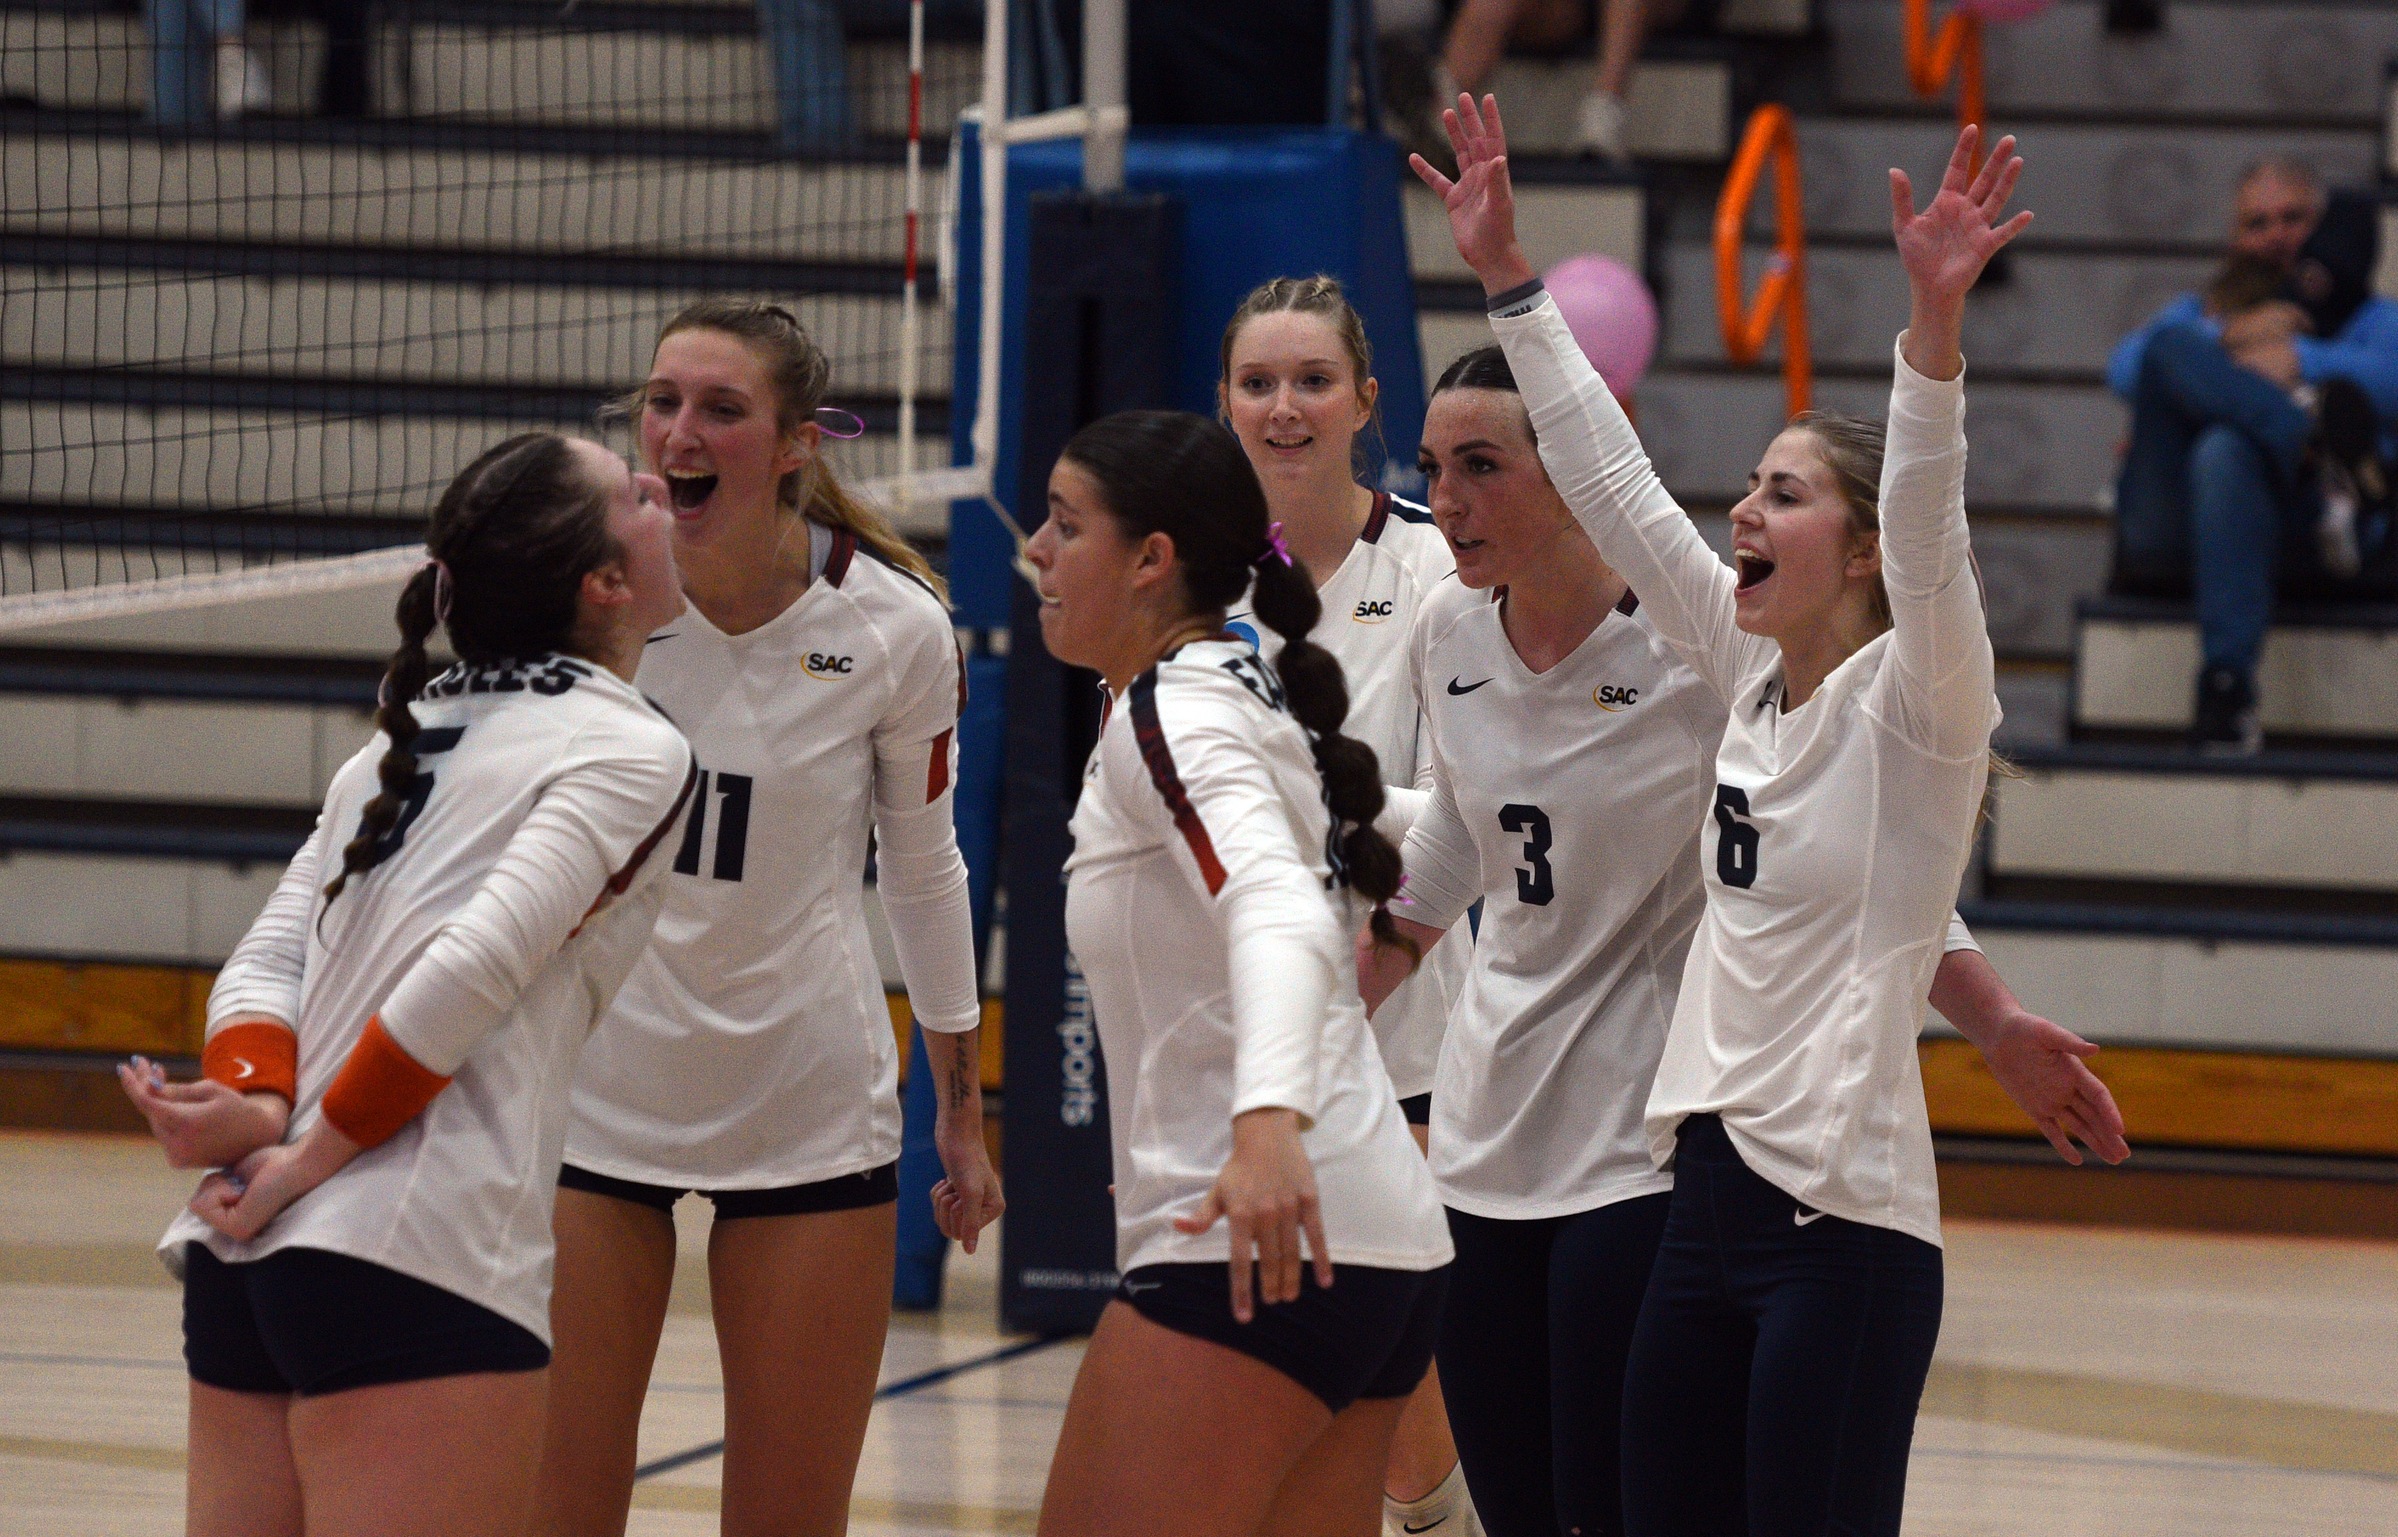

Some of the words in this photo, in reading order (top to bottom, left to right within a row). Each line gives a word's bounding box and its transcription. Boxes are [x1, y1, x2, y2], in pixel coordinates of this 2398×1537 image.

[1355, 601, 1393, 617] SAC
[807, 653, 853, 674] SAC
[1598, 685, 1638, 706] SAC
[673, 769, 752, 882] 11
[1497, 803, 1555, 906] 3
[1713, 783, 1760, 889] 6
